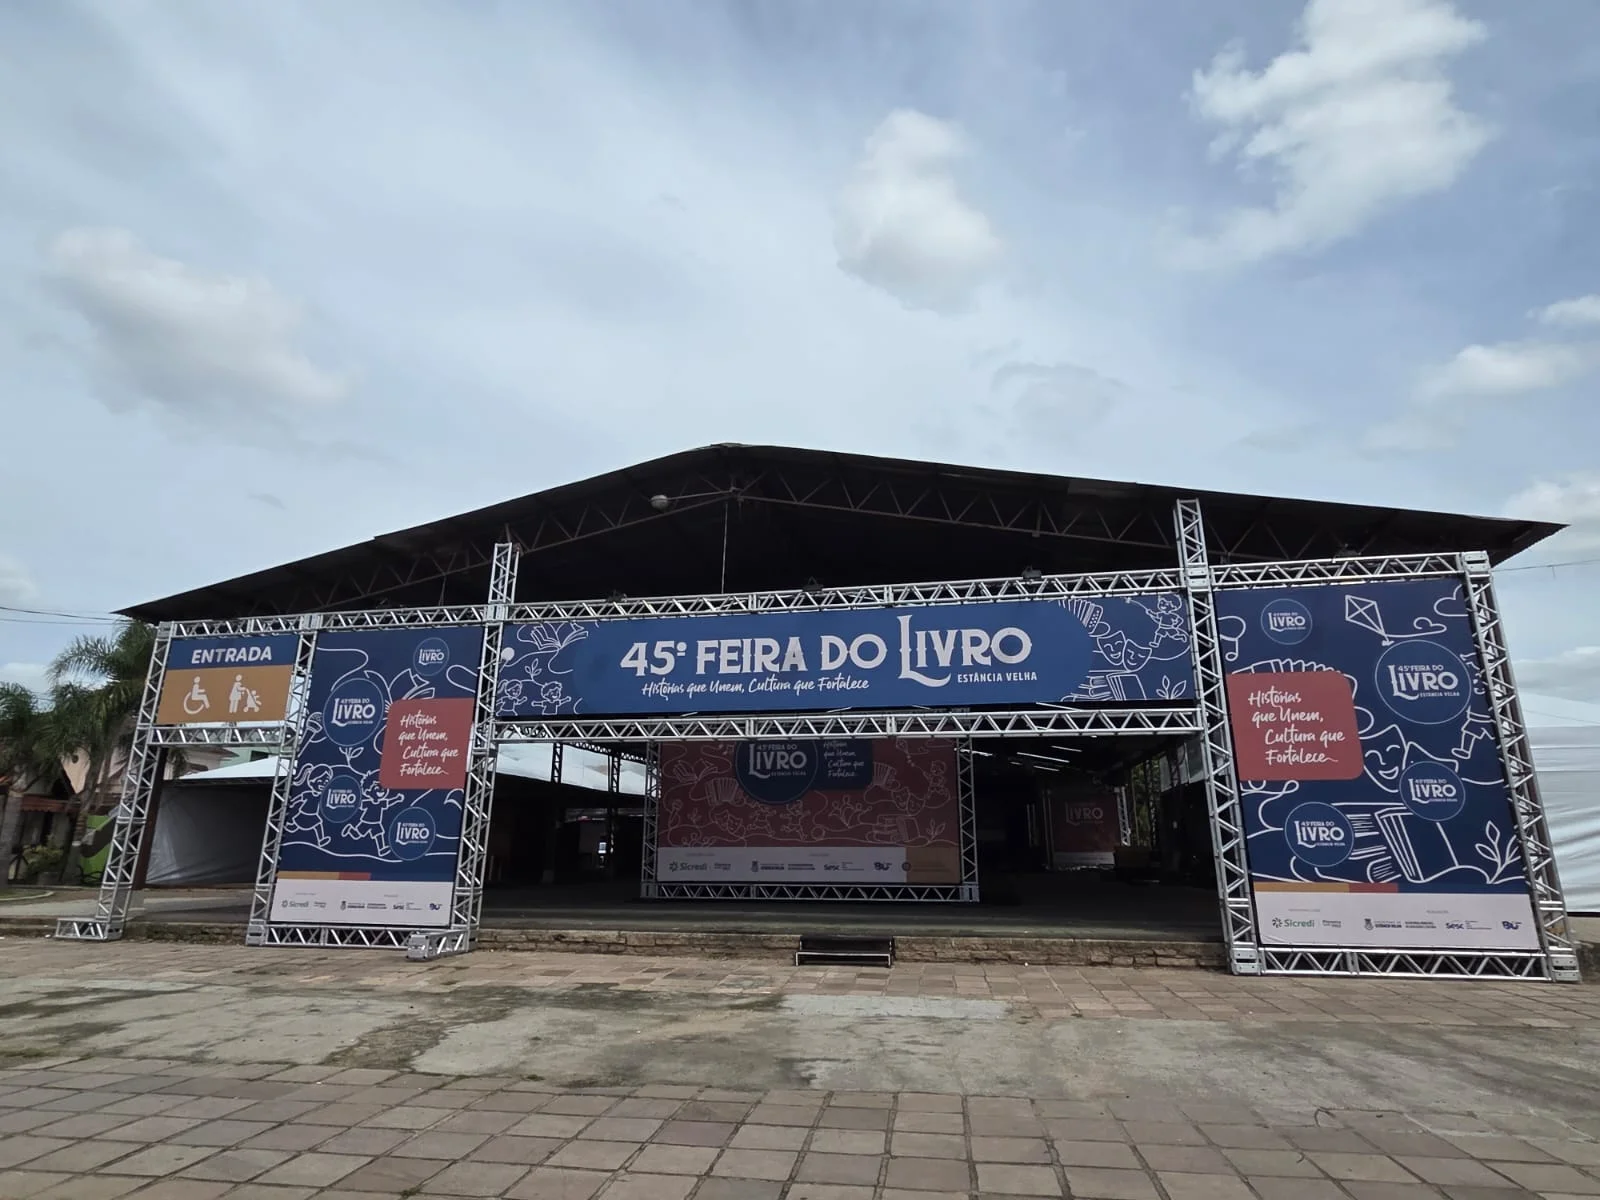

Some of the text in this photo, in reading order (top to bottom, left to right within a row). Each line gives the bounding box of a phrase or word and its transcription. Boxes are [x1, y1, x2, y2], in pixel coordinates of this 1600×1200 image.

[1268, 612, 1306, 632] LIVRO
[191, 646, 272, 664] ENTRADA
[418, 648, 445, 665] LIVRO
[695, 636, 809, 676] FEIRA
[820, 633, 889, 671] DO
[897, 614, 1033, 688] LIVRO
[686, 682, 708, 699] que
[709, 680, 745, 693] Unem,
[748, 673, 791, 693] Cultura
[793, 679, 816, 696] que
[817, 672, 870, 691] Fortalece
[957, 671, 1038, 684] ESTÂNCIA VELHA
[1387, 664, 1459, 700] LIVRO
[1247, 685, 1302, 708] Histórias
[331, 698, 375, 727] LIVRO
[1251, 711, 1277, 728] que
[398, 731, 416, 746] que
[1265, 723, 1346, 748] Cultura que
[402, 742, 459, 763] Cultura que
[748, 743, 808, 779] LIVRO
[1265, 744, 1339, 766] Fortalece
[399, 759, 449, 777] Fortalece
[326, 788, 357, 809] LIVRO
[1408, 778, 1457, 804] LIVRO
[1064, 801, 1104, 827] LIVRO
[395, 821, 430, 845] LIVRO
[1294, 820, 1345, 848] LIVRO
[1283, 918, 1315, 928] Sicredi
